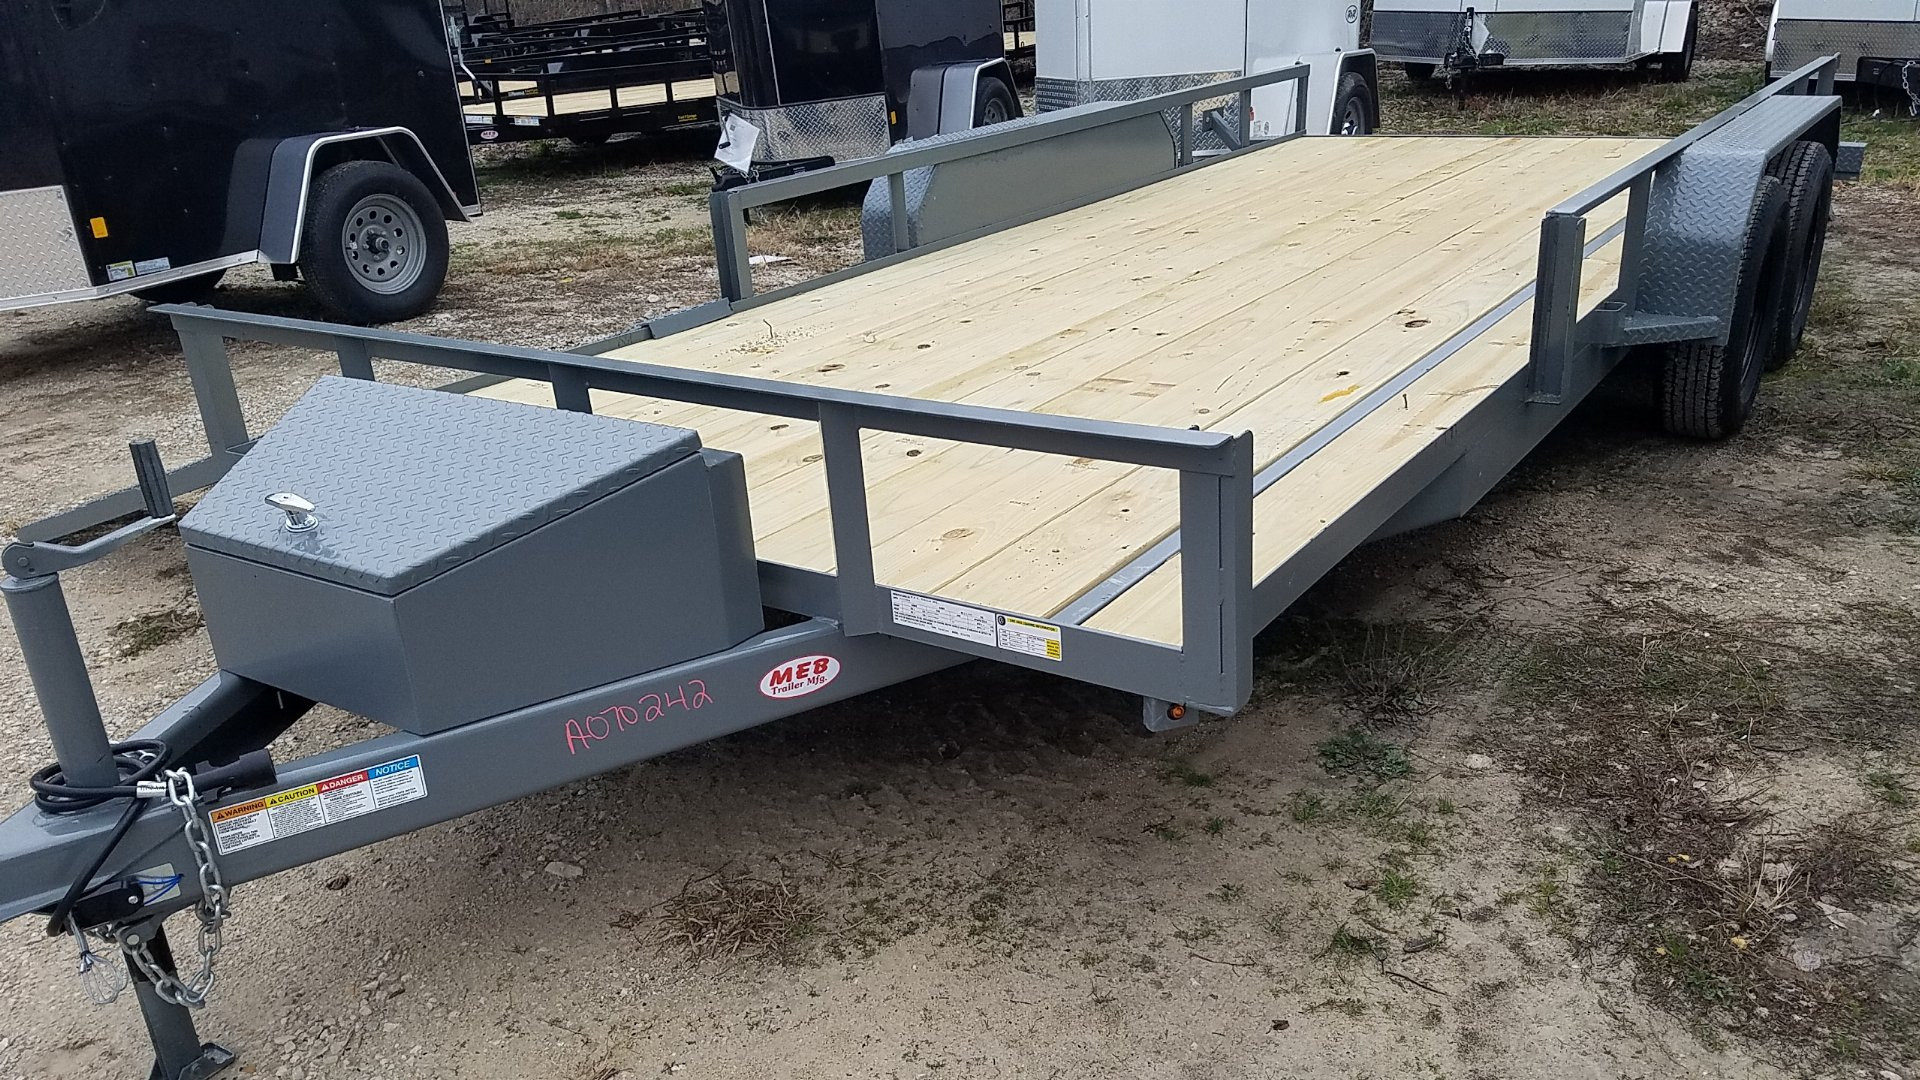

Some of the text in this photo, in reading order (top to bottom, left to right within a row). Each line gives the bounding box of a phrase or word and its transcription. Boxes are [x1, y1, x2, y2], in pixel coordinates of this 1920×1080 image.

[769, 657, 830, 687] MEB
[771, 674, 828, 695] Trailer Mfg.
[375, 760, 411, 776] NOTICE
[329, 774, 364, 788] DANGER
[278, 787, 315, 803] CAUTION
[224, 801, 264, 817] WARNING
